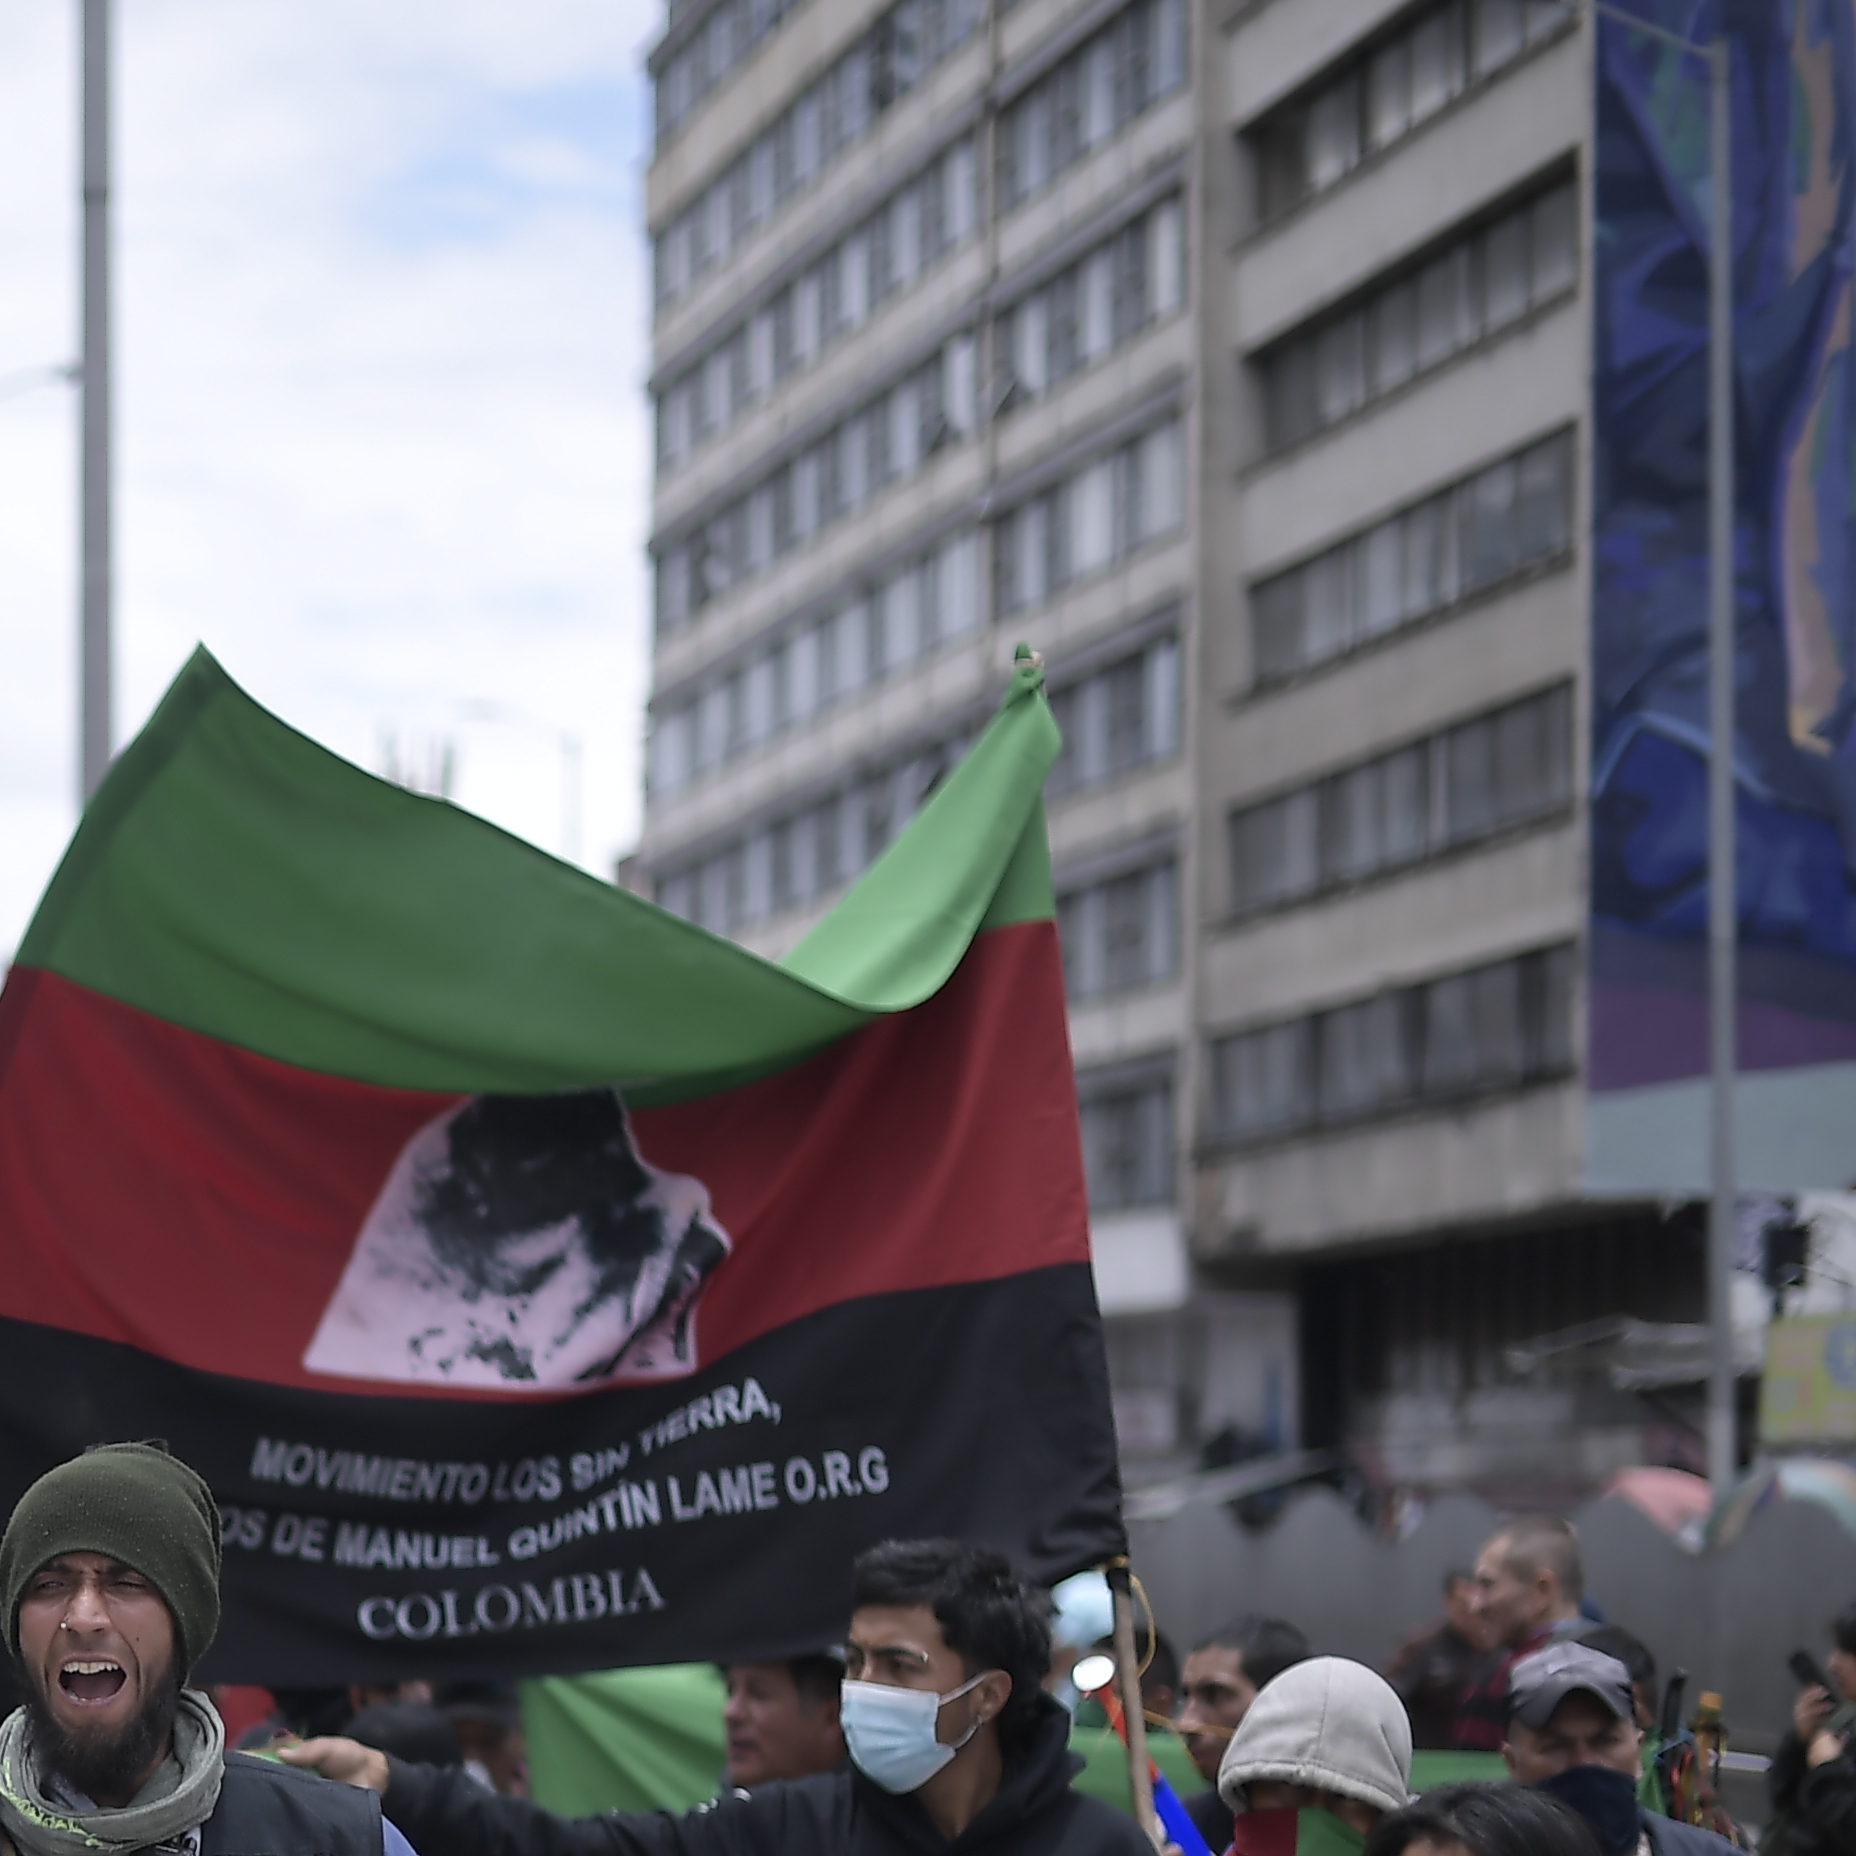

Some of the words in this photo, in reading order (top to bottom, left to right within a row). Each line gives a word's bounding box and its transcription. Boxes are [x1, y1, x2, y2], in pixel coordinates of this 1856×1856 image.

[250, 1435, 489, 1504] MOVIMIENTO
[491, 1454, 563, 1501] LOS
[569, 1441, 631, 1492] SIN
[637, 1376, 783, 1456] TIERRA,
[271, 1512, 330, 1562] DE
[332, 1520, 501, 1570] MANUEL
[666, 1460, 780, 1521] LAME
[784, 1444, 890, 1504] O.R.G
[356, 1565, 666, 1641] COLOMBIA
